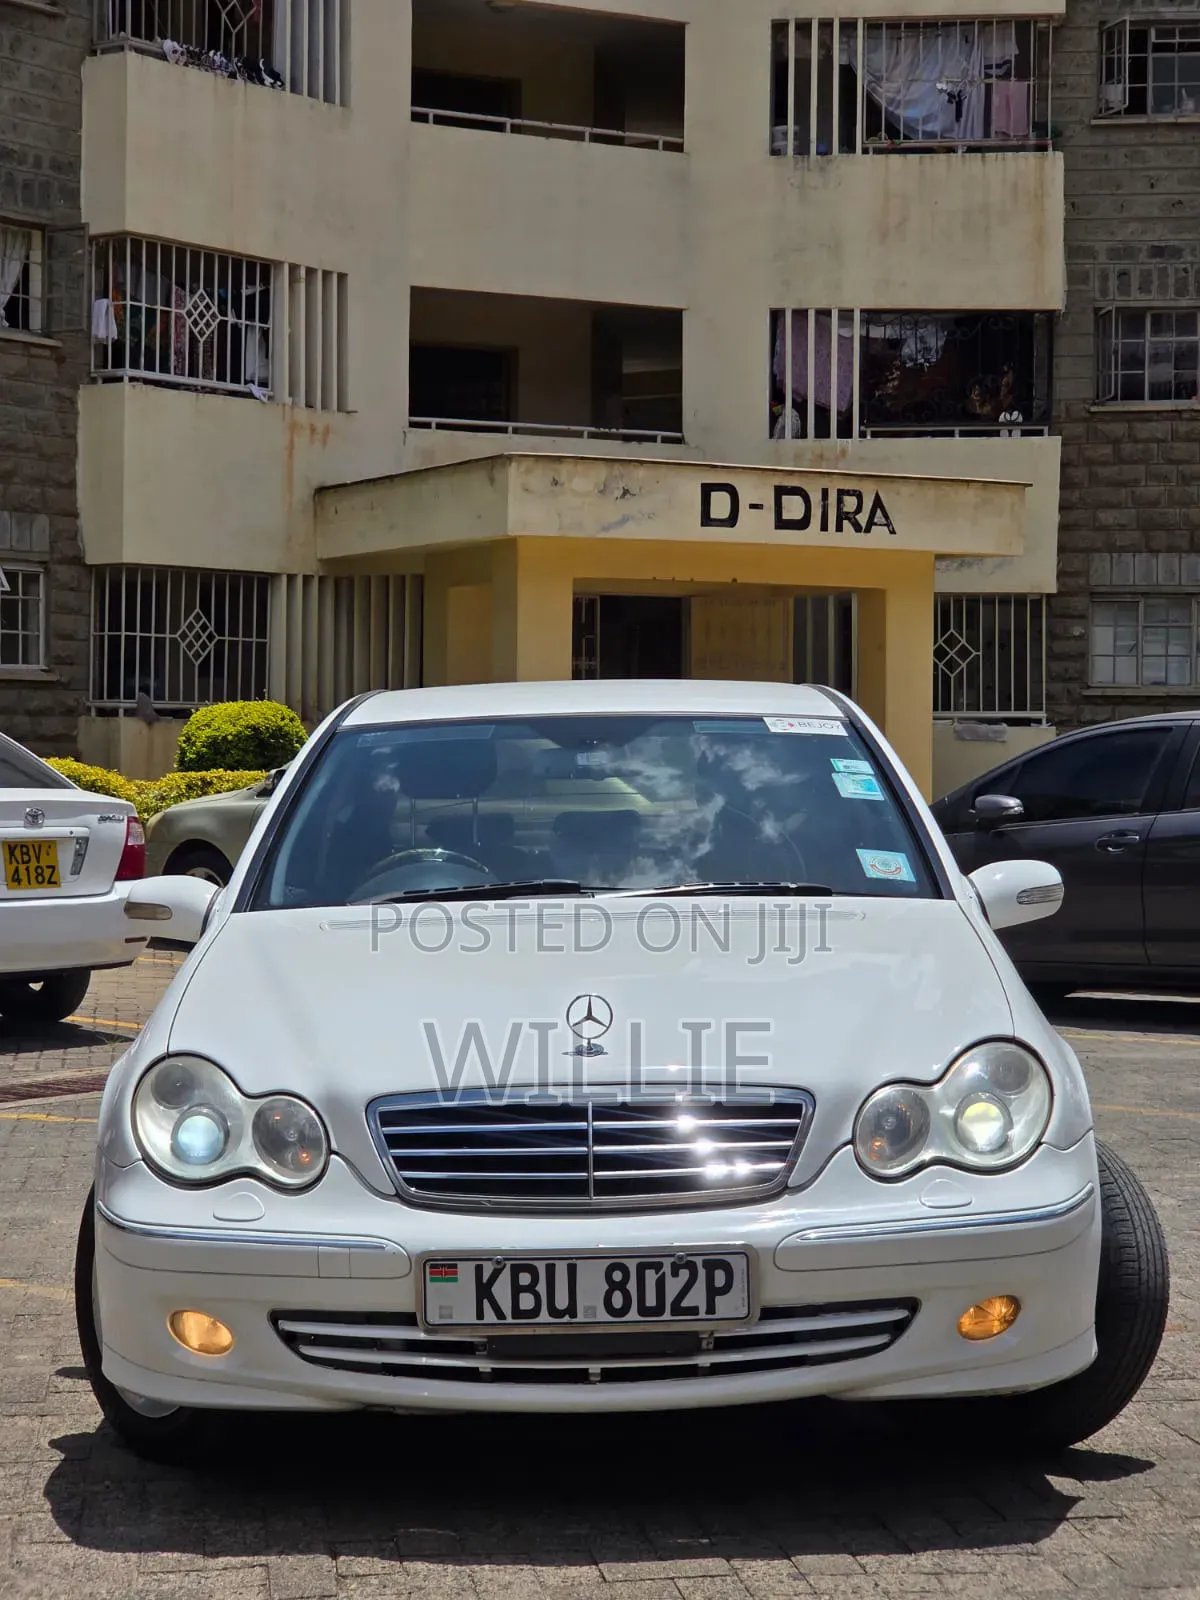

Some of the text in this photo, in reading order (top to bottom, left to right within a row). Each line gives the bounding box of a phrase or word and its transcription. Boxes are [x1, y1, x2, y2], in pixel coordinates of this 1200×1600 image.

[700, 482, 897, 535] D-DIRA
[7, 843, 42, 865] KBV
[11, 865, 58, 887] 418Z
[474, 1262, 578, 1321] KBU
[602, 1258, 735, 1318] 802P
